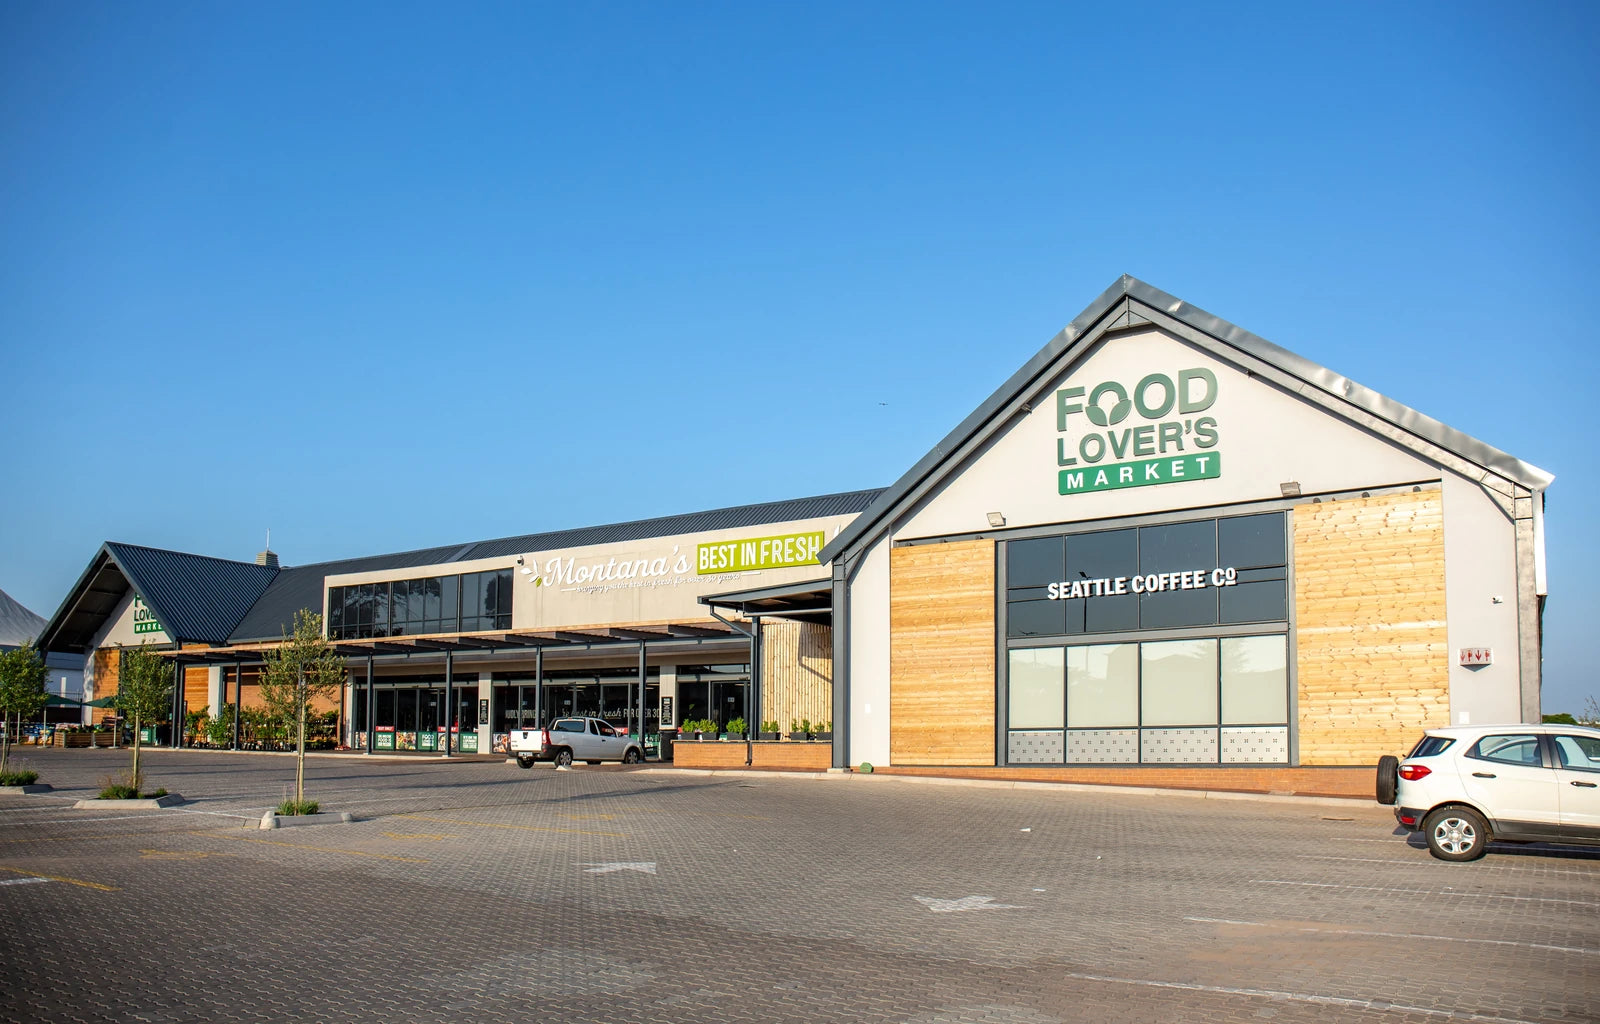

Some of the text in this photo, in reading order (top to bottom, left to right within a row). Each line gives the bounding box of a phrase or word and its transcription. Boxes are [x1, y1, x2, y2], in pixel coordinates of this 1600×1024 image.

[1057, 367, 1218, 432] FOOD
[1057, 417, 1219, 466] LOVER'S
[1067, 457, 1210, 489] MARKET
[542, 544, 692, 587] Montana's
[700, 535, 820, 570] BEST IN FRESH
[1048, 577, 1127, 600] SEATTLE
[1131, 569, 1206, 594] COFFEE
[136, 623, 162, 632] MARKE
